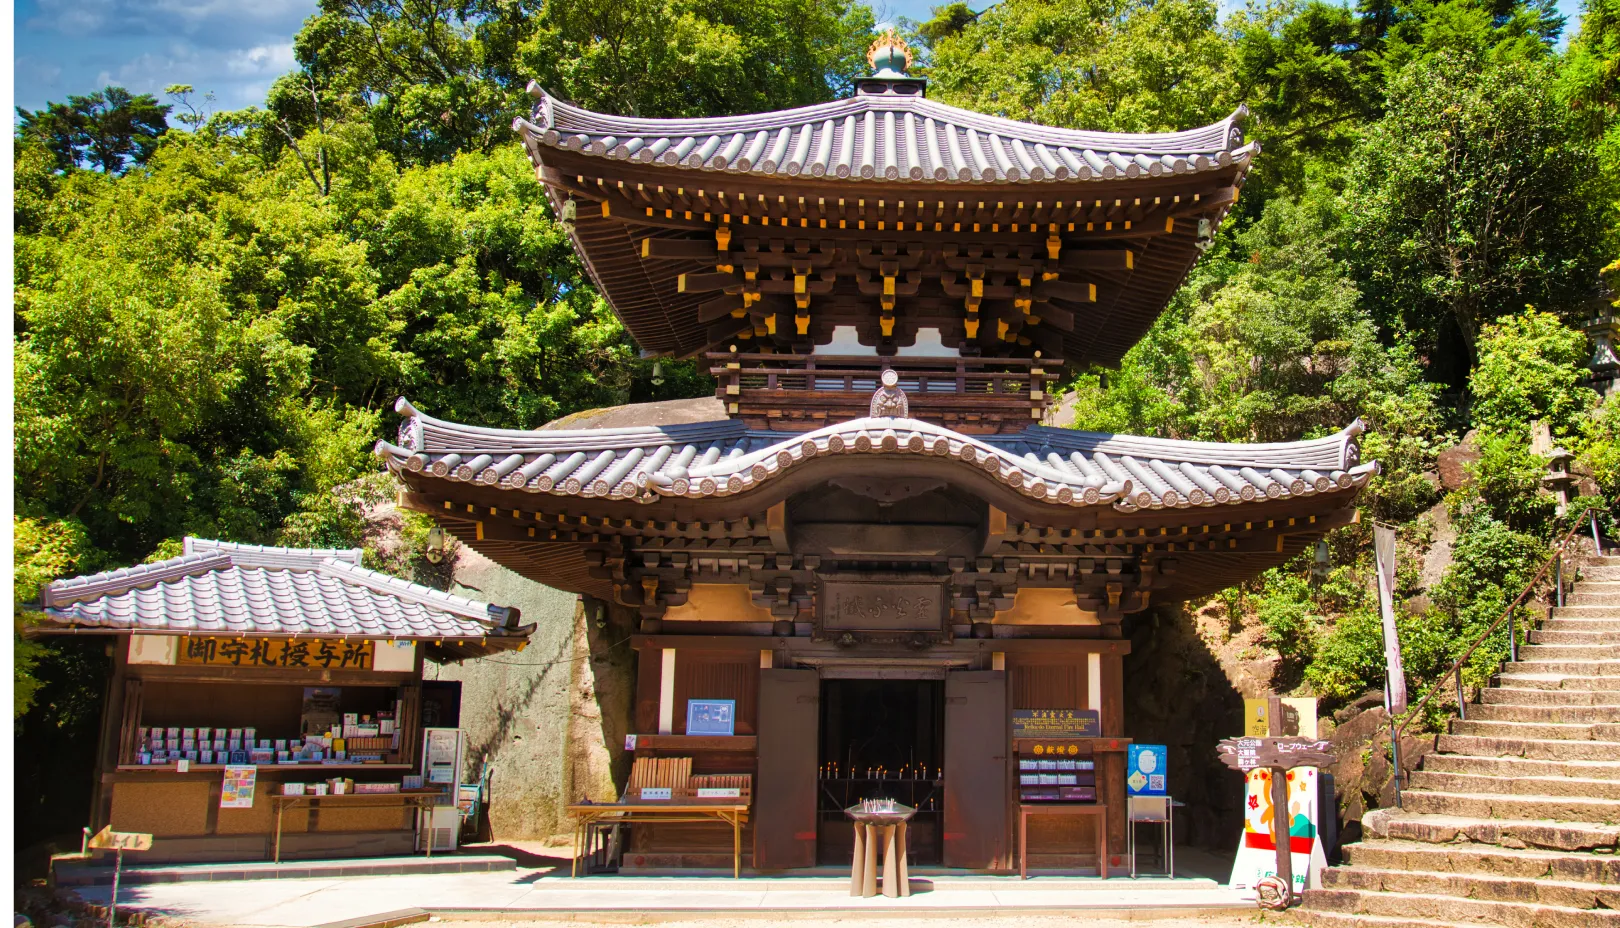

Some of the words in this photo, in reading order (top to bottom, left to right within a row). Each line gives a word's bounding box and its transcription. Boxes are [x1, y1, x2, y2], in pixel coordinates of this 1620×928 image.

[187, 637, 369, 669] 御守札授与所
[111, 834, 144, 848] トイレ
